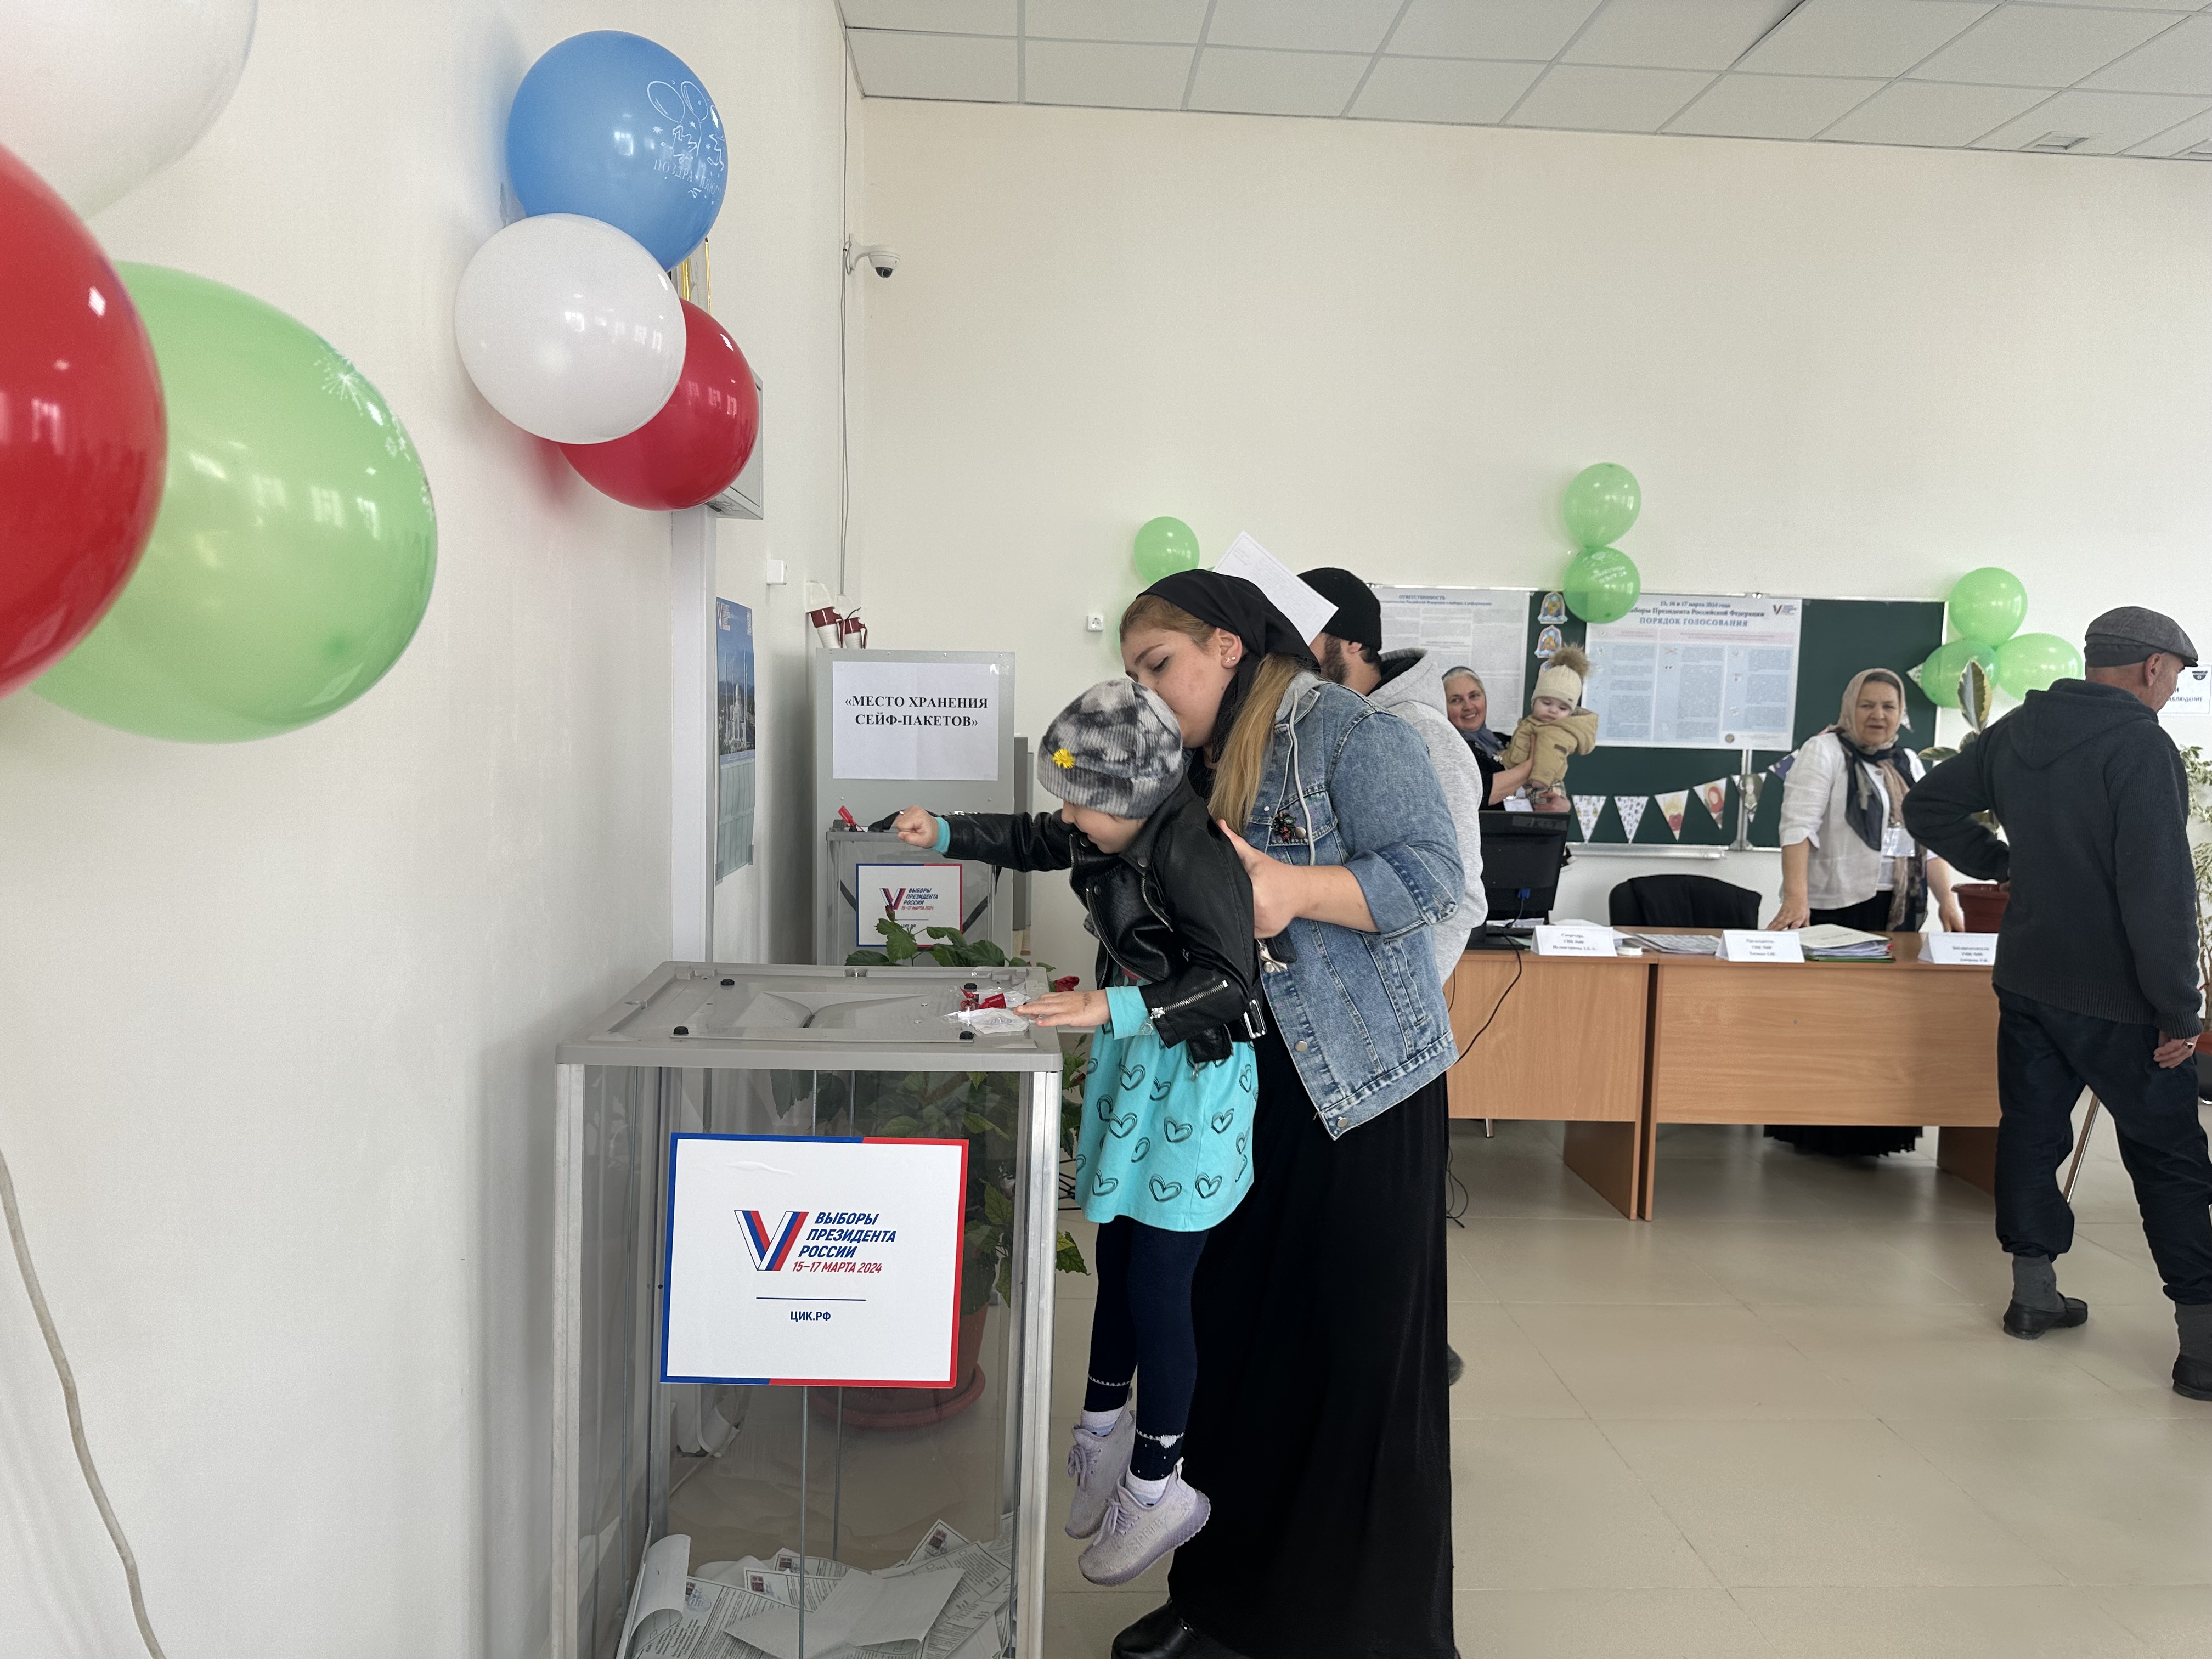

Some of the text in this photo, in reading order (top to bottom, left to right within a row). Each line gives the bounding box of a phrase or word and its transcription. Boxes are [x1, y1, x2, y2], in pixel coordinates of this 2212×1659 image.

[1629, 607, 1651, 615] ыборы
[1652, 607, 1690, 616] Президента
[1683, 618, 1748, 627] ГОЛОСОВАНИЯ
[845, 696, 988, 709] «МЕСТО ХРАНЕНИЯ
[855, 712, 978, 727] СЕЙФ-ПАКЕТОВ»
[814, 1212, 880, 1225] ВЫБОРЫ
[806, 1229, 897, 1244] ПРЕЗИДЕНТА
[798, 1245, 858, 1259] РОССИИ
[821, 1261, 856, 1273] МАРТА
[856, 1262, 882, 1273] 2024
[790, 1311, 832, 1322] ЦИК.РФ
